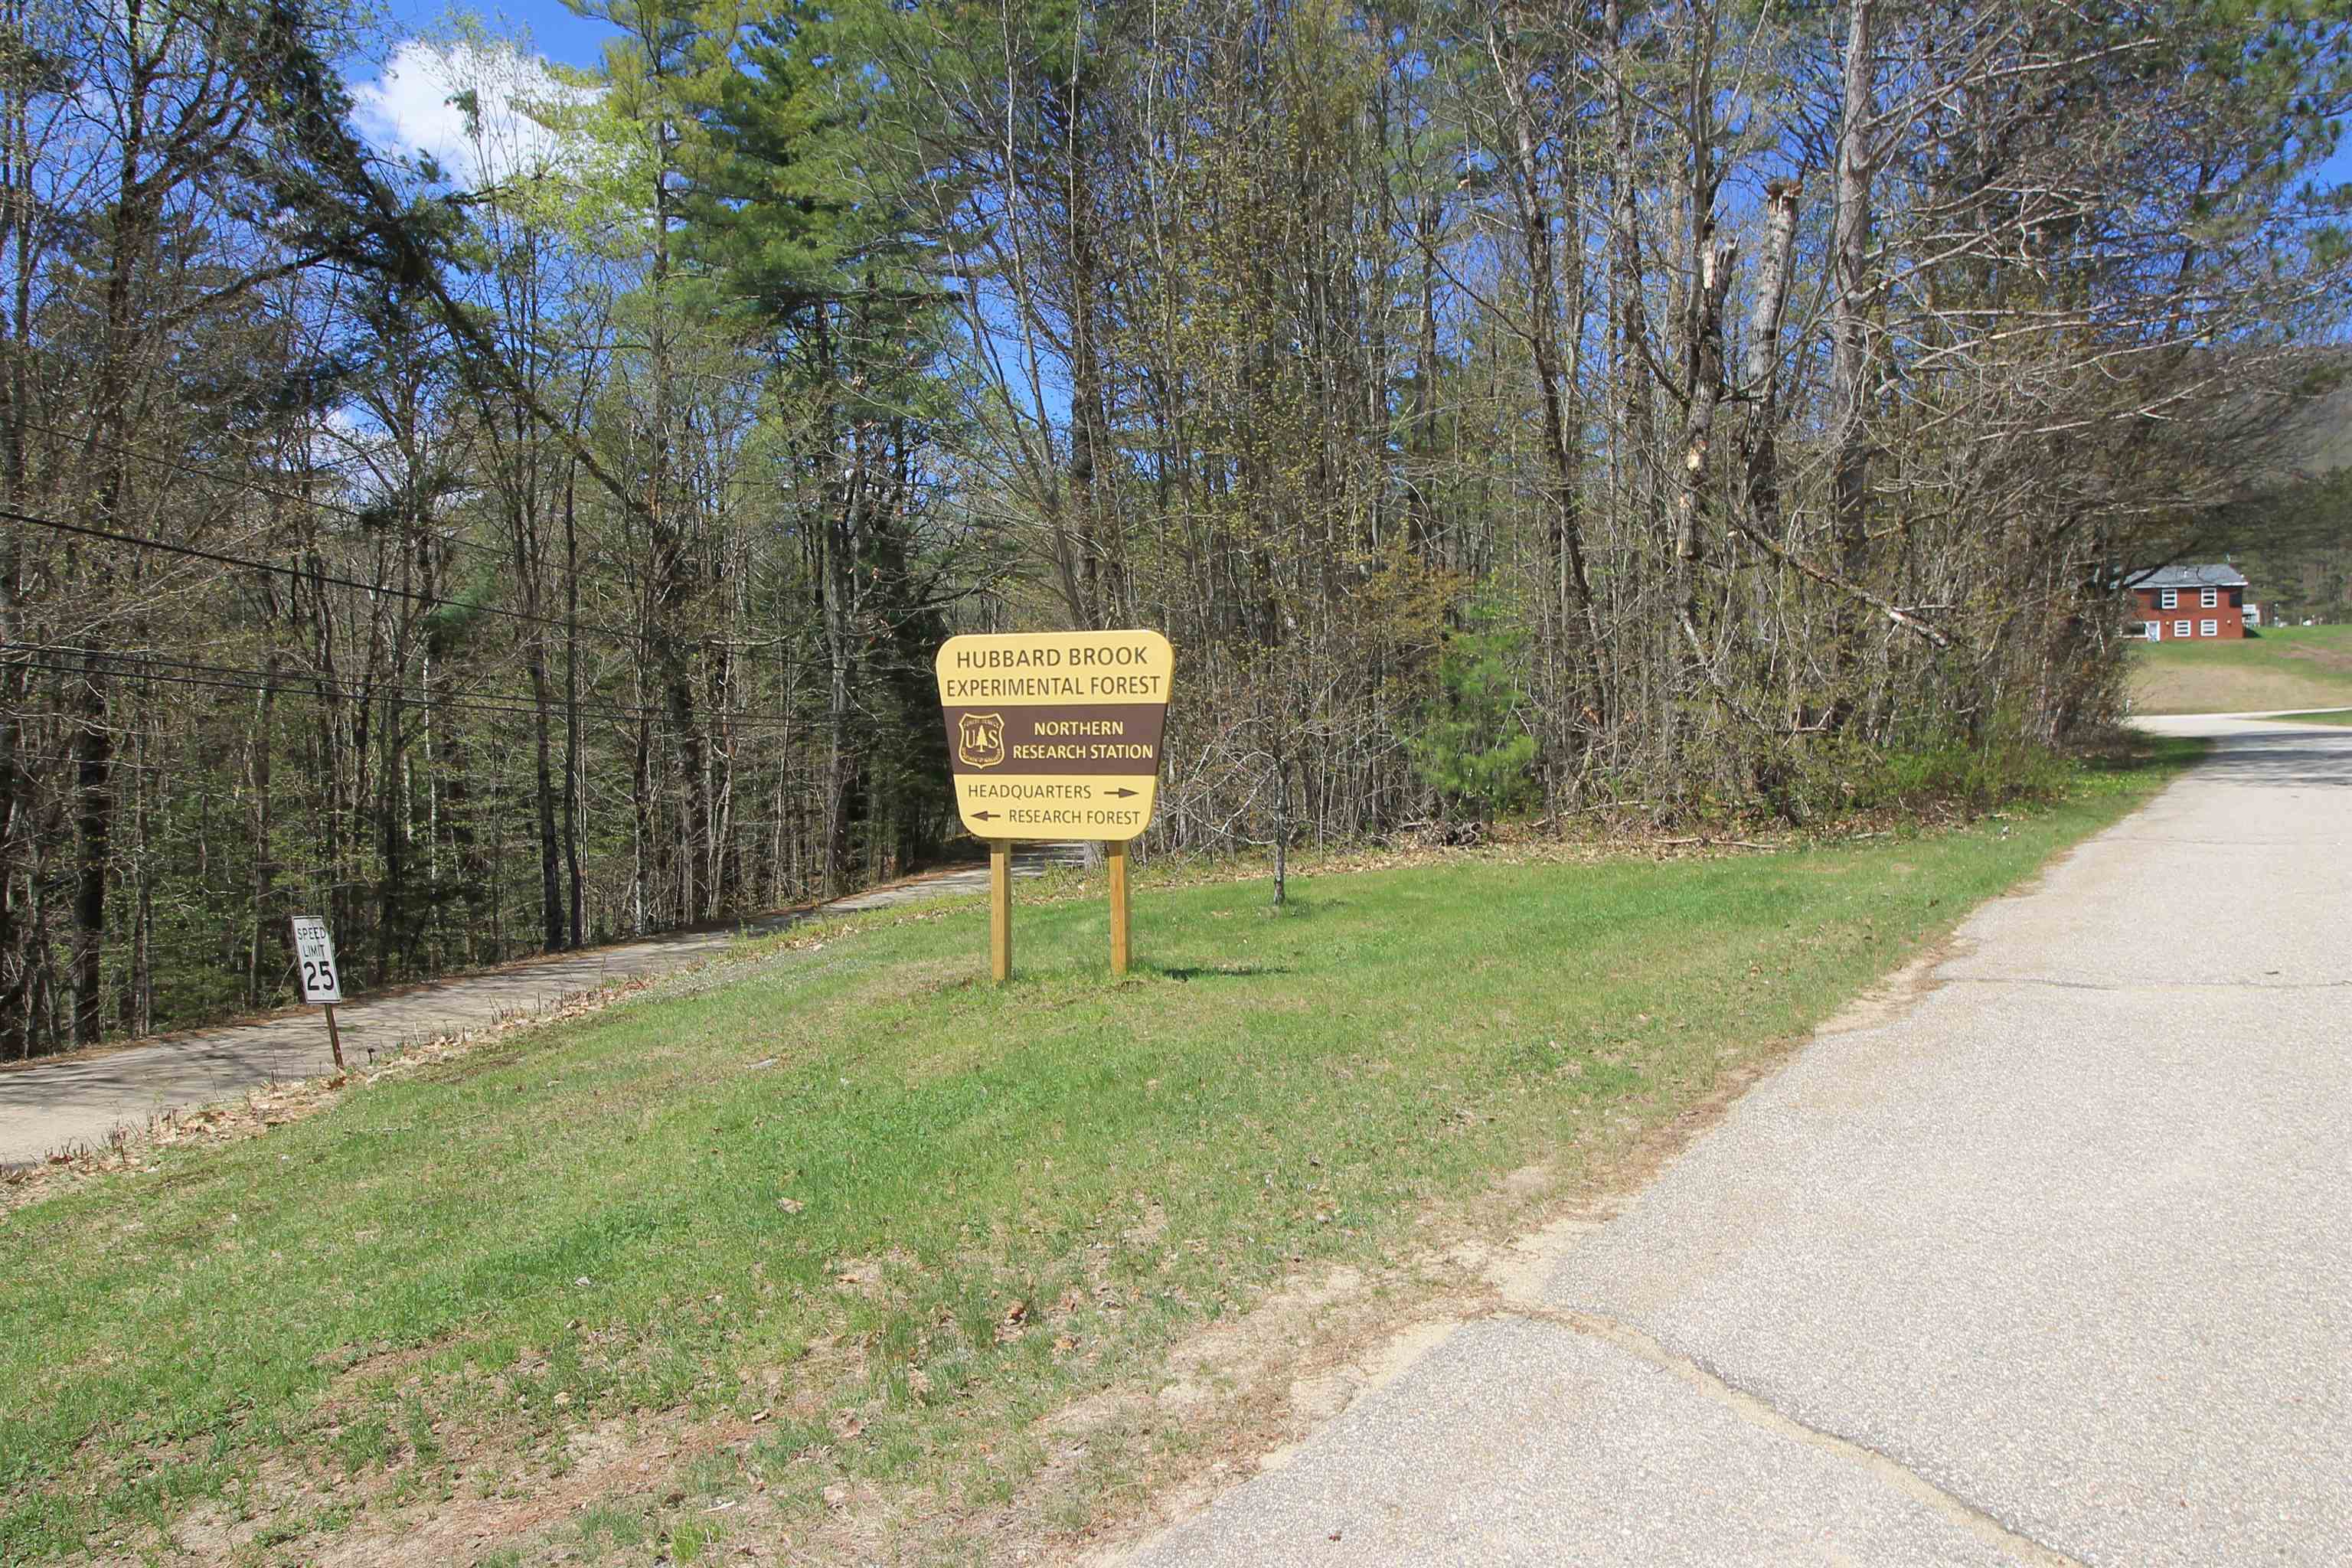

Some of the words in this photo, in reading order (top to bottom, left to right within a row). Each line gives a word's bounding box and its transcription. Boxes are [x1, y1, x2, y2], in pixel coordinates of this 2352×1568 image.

[957, 648, 1060, 668] HUBBARD
[1070, 646, 1148, 665] BROOK
[947, 677, 1084, 697] EXPERIMENTAL
[1091, 675, 1161, 695] FOREST
[1034, 721, 1124, 736] NORTHERN
[1013, 744, 1086, 760] RESEARCH
[1090, 744, 1153, 760] STATION
[969, 784, 1091, 799] HEADQUARTERS
[1009, 809, 1081, 823] RESEARCH
[1087, 810, 1140, 825] FOREST
[297, 926, 325, 941] SPEED
[302, 944, 325, 958] LIMIT
[303, 961, 334, 991] 25
